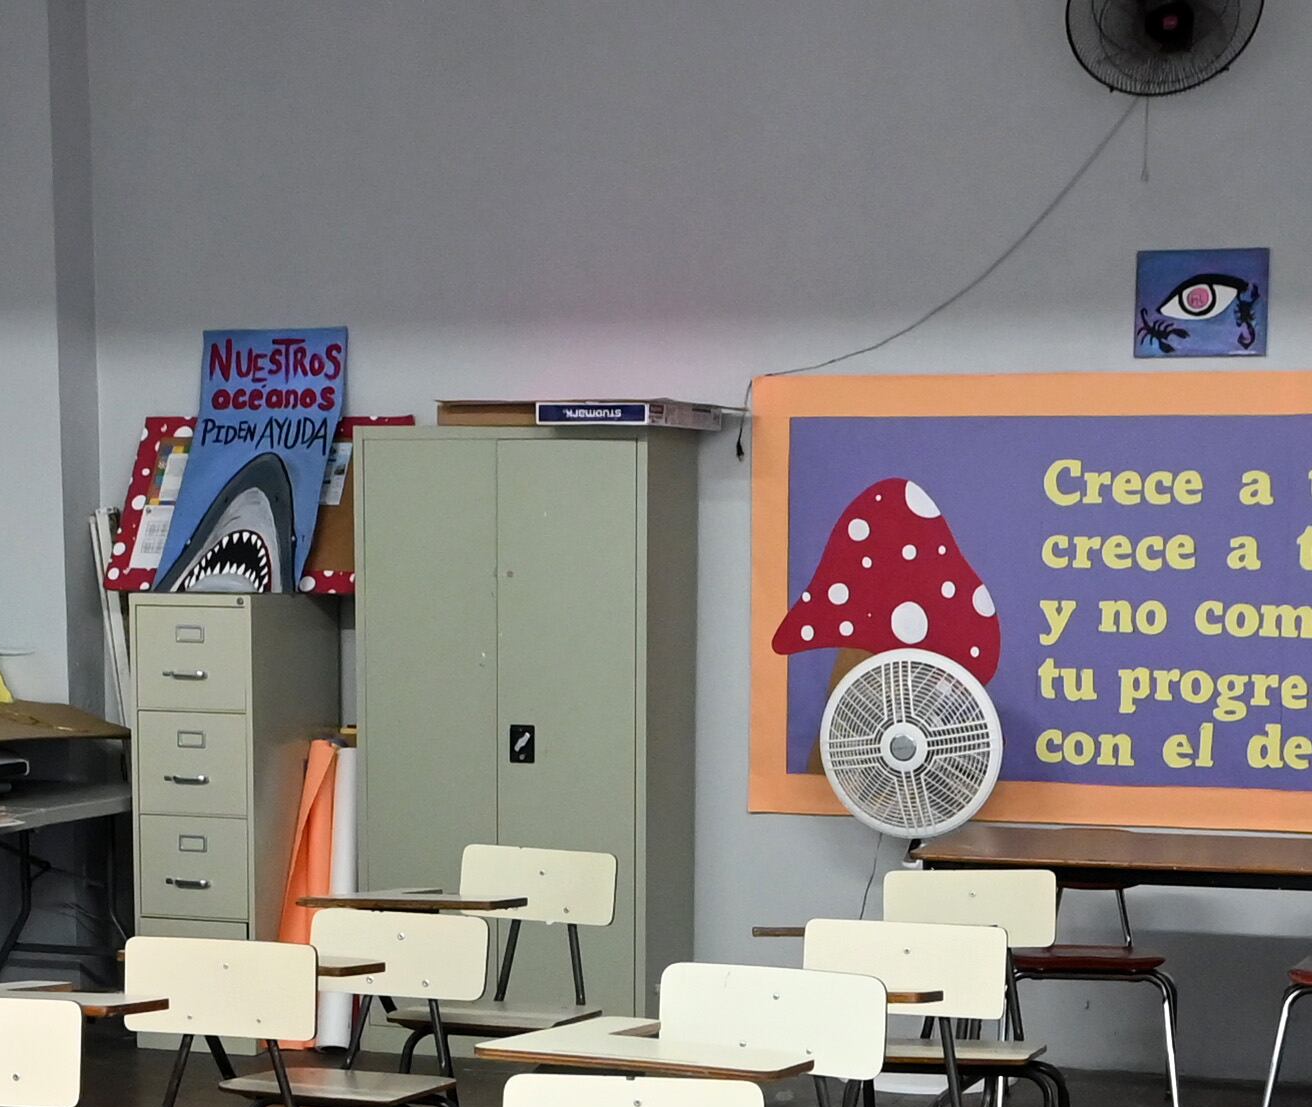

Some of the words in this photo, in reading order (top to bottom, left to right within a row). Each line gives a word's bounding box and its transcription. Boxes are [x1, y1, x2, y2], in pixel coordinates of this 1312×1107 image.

[209, 337, 343, 385] NUESTROS
[200, 417, 257, 447] PIDEN
[255, 416, 329, 456] AYUDA
[1043, 458, 1205, 507] Crece
[1239, 469, 1276, 506] a
[1042, 533, 1197, 572] crece
[1227, 535, 1263, 571] a
[1039, 599, 1078, 646] y
[1098, 599, 1169, 636] no
[1039, 657, 1099, 702] tu
[1035, 728, 1137, 767] con
[1163, 721, 1216, 769] el
